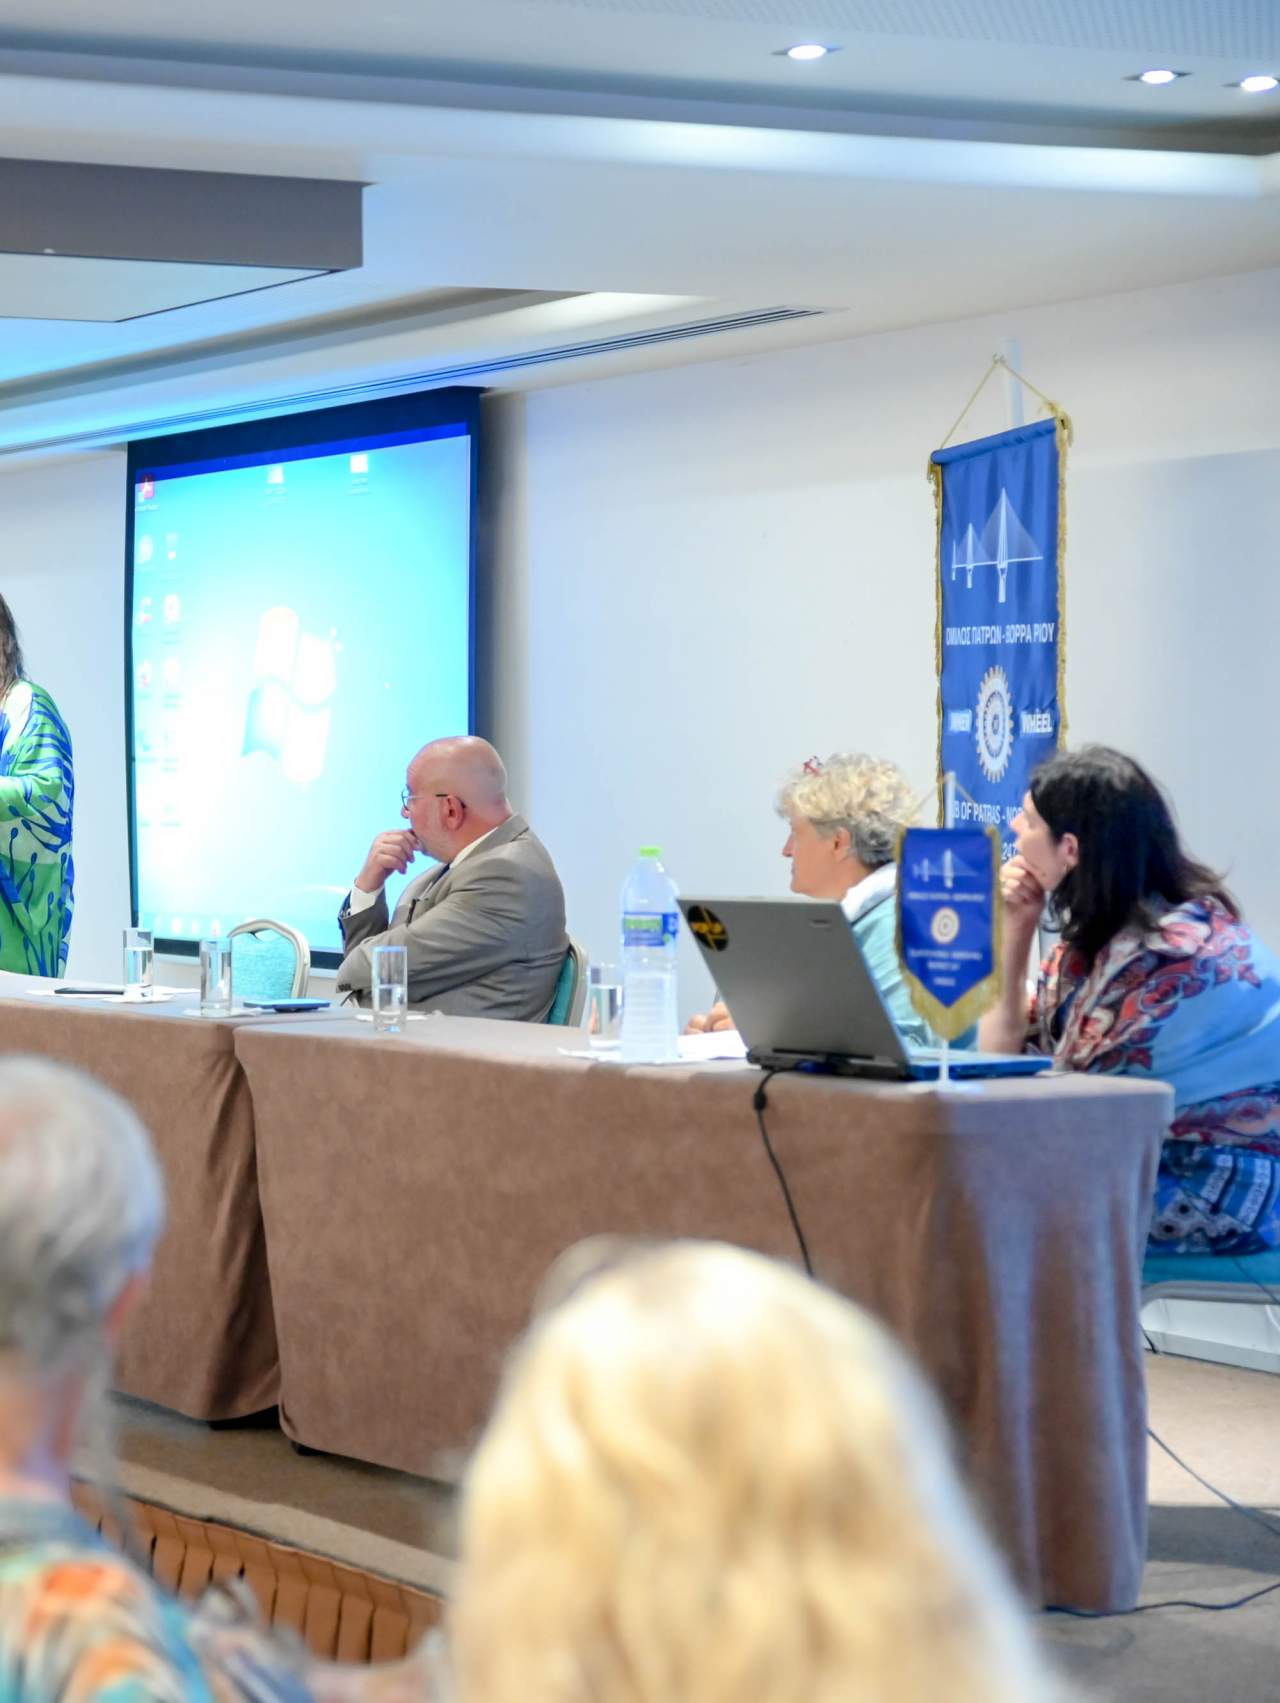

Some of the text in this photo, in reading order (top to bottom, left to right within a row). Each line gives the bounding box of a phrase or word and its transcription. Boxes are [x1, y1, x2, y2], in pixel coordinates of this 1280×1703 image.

[972, 624, 1002, 645] ΠΑΤΡΩΝ
[1033, 622, 1055, 643] ΡΙΟΥ
[961, 801, 972, 820] OF
[973, 802, 1001, 824] PATRAS
